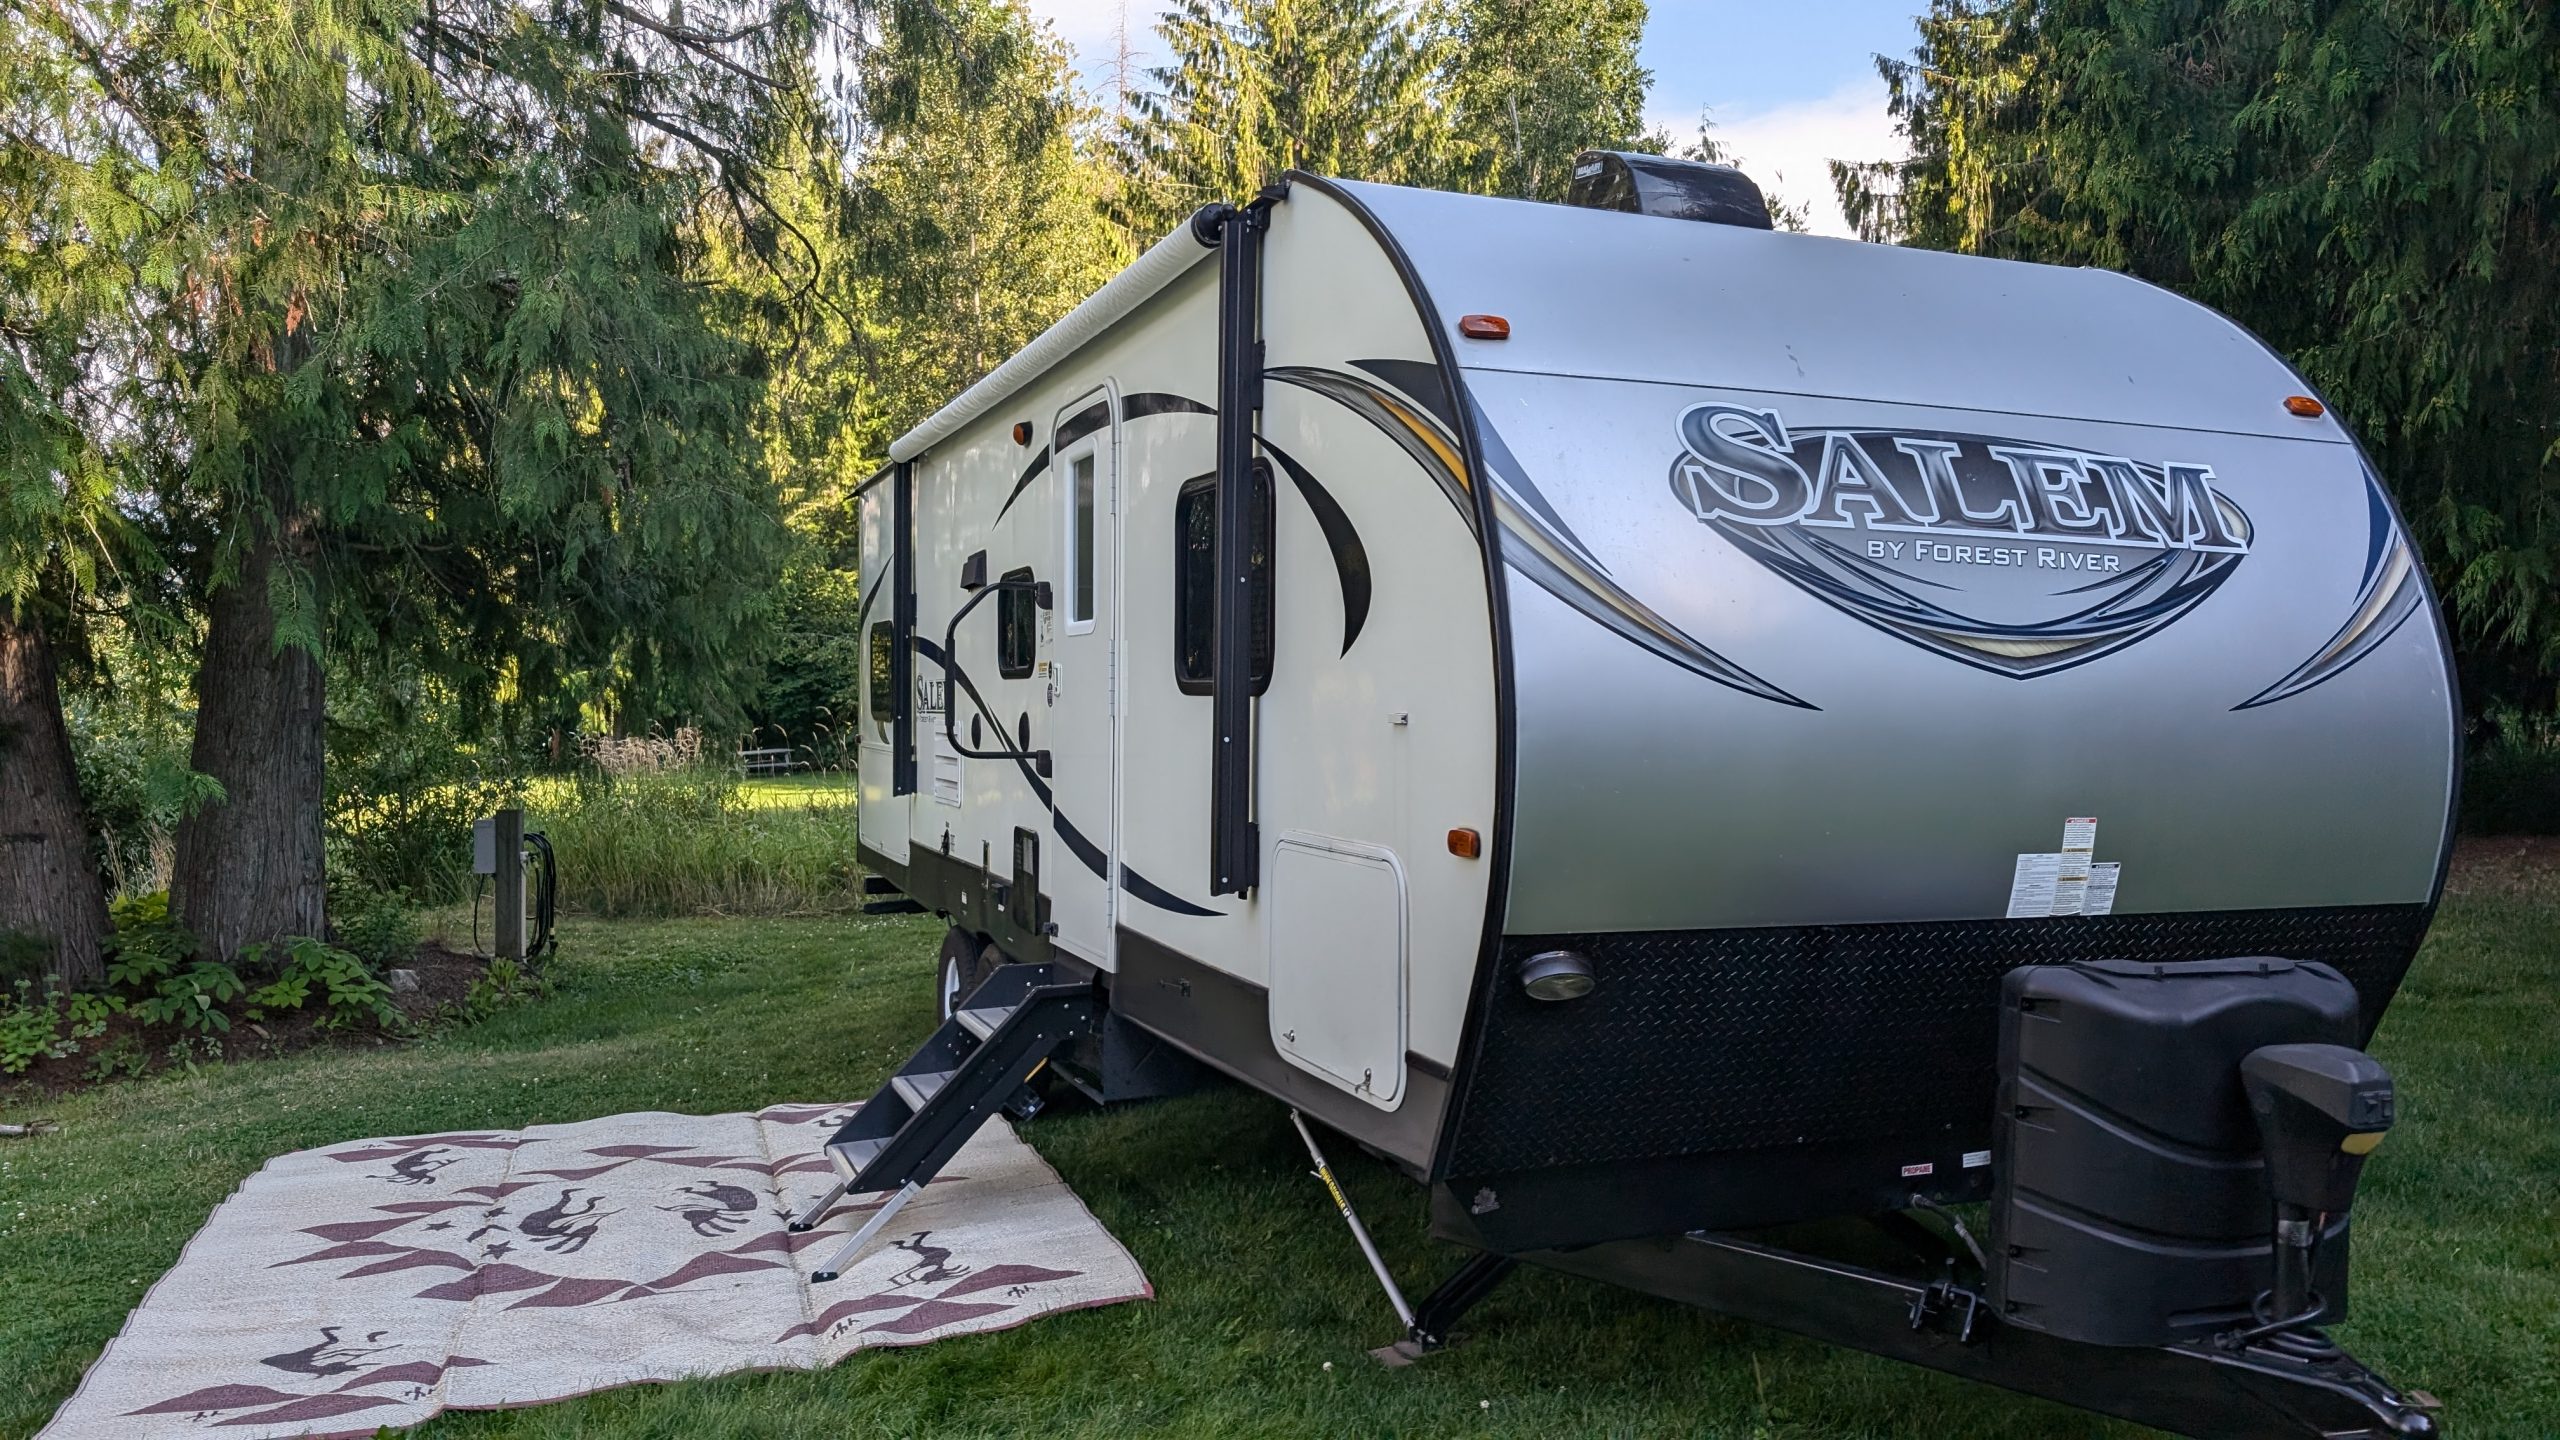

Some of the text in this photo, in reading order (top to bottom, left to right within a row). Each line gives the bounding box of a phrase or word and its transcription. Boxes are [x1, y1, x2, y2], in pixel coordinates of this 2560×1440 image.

[1675, 401, 2249, 554] SALEM
[1867, 539, 2121, 573] BY FOREST RIVER
[916, 674, 946, 710] SALE
[1903, 1164, 1931, 1176] PROPANE
